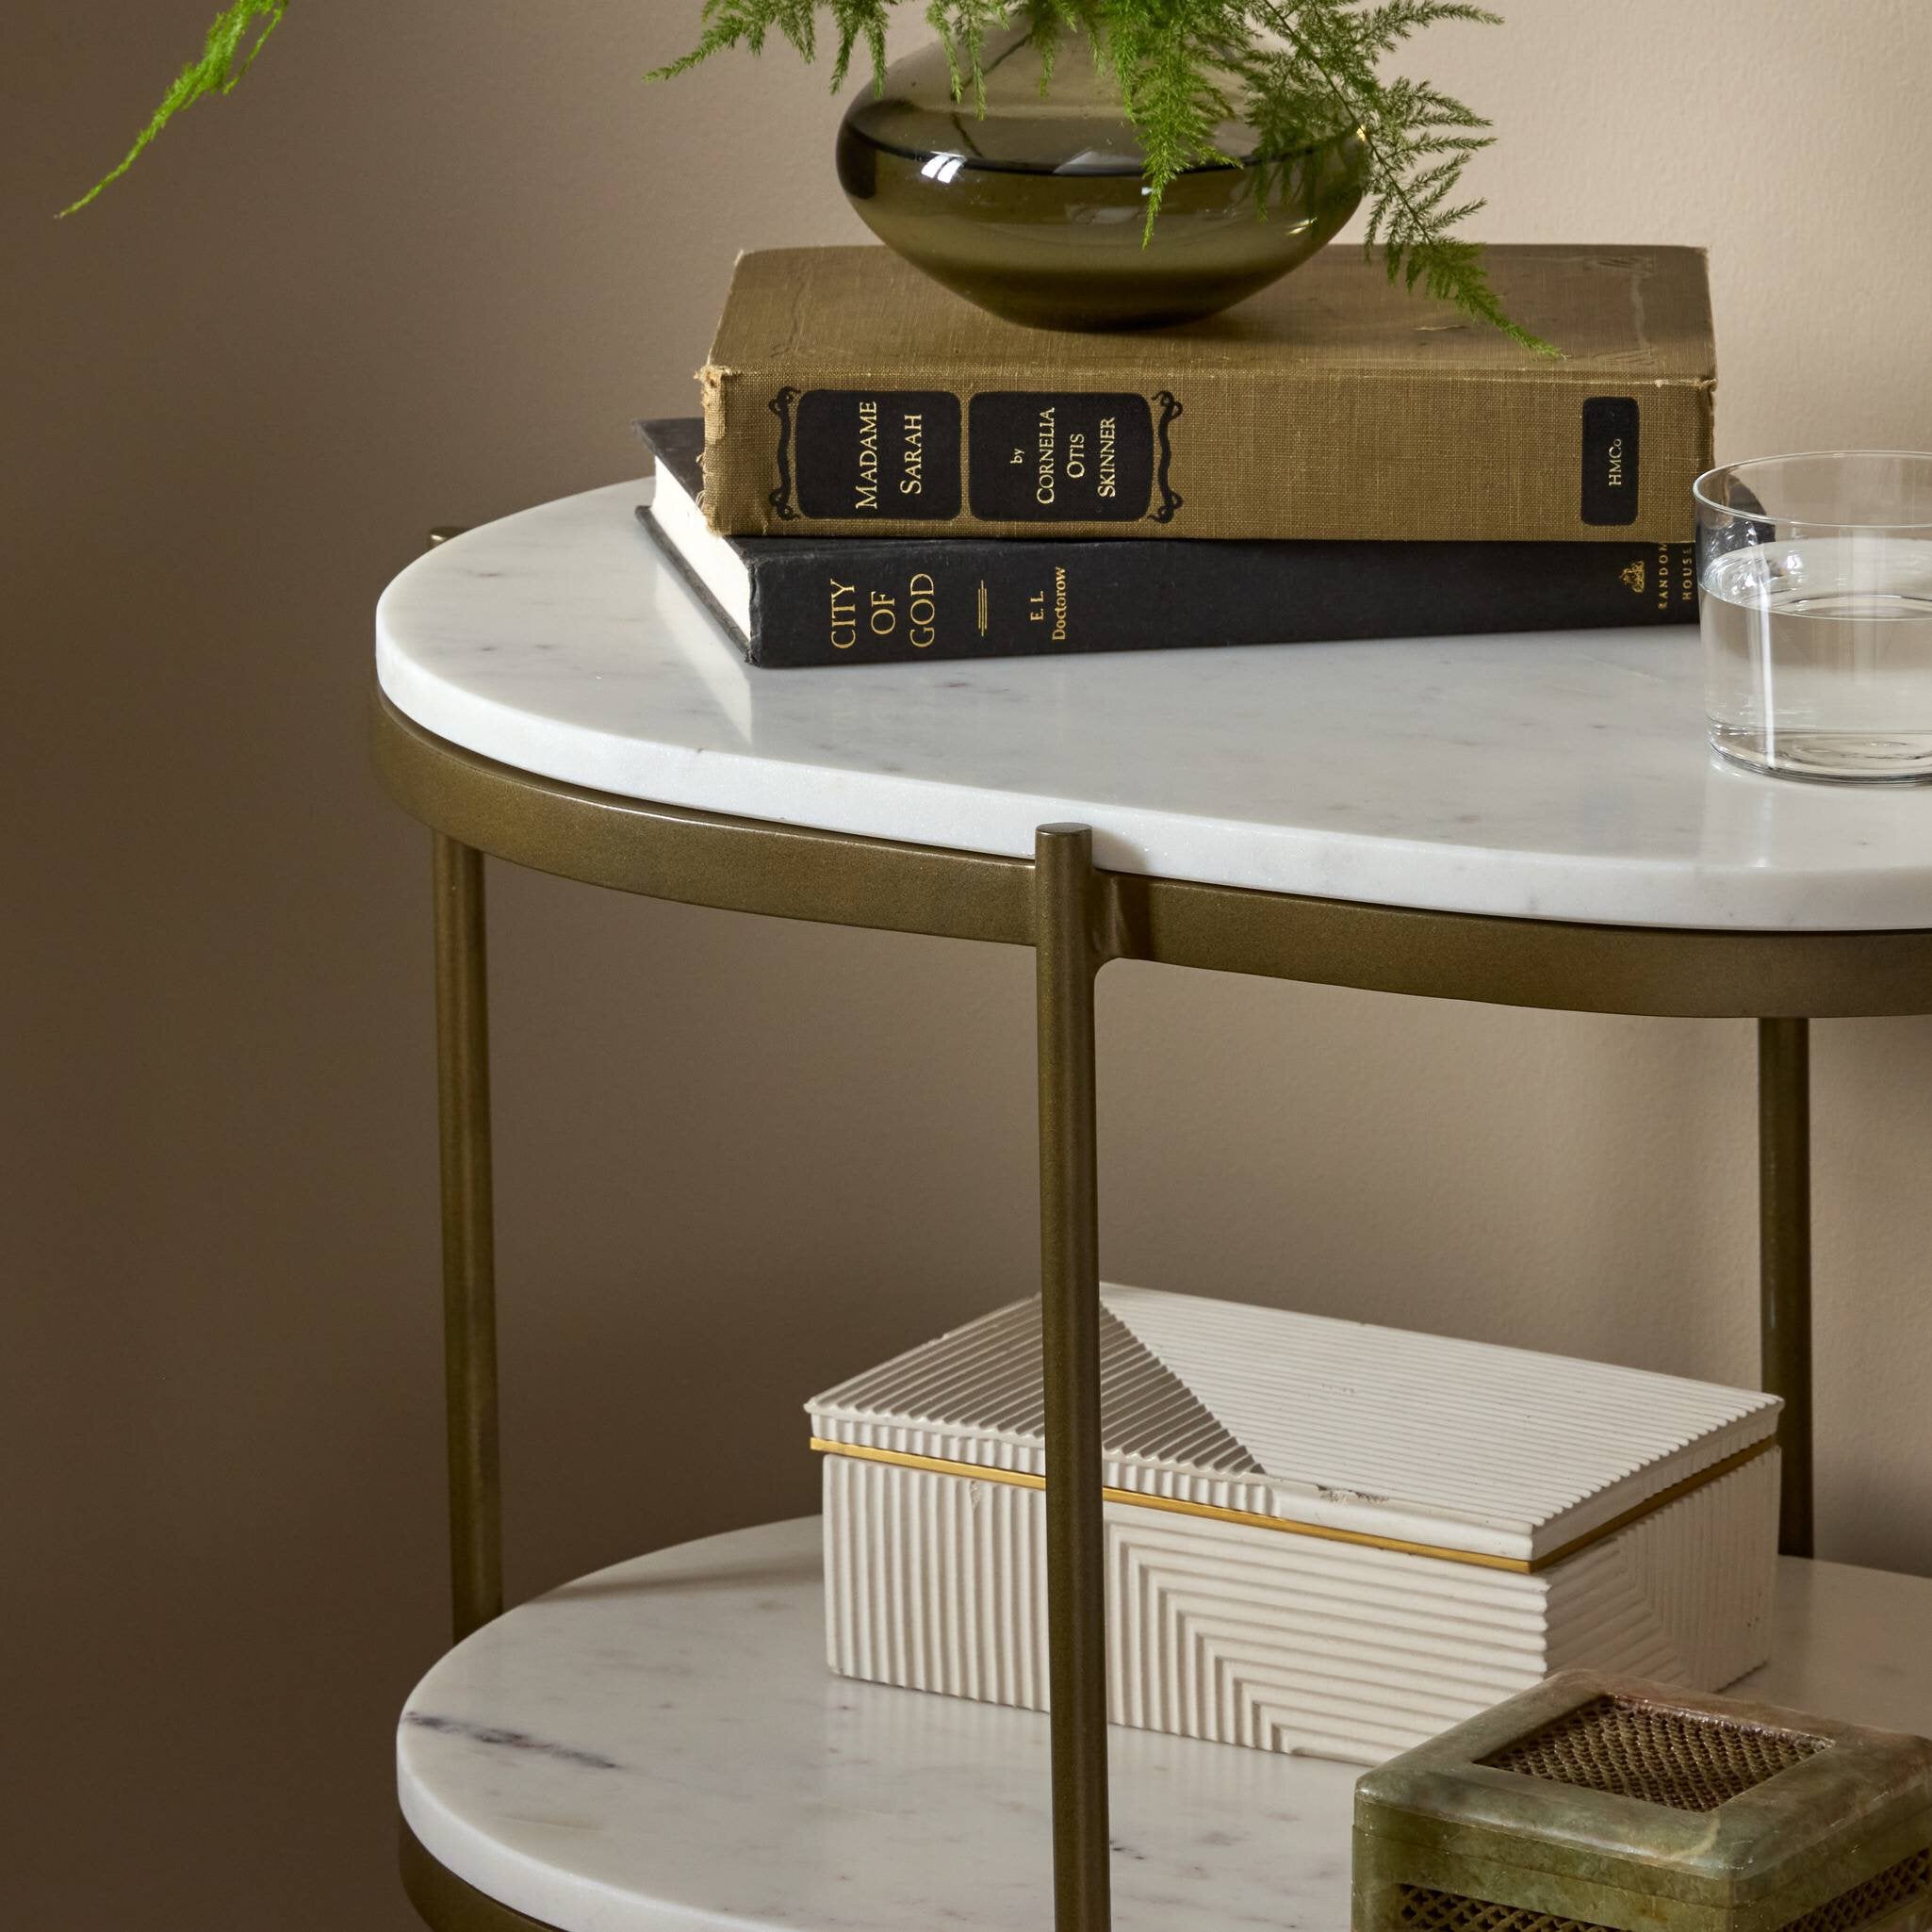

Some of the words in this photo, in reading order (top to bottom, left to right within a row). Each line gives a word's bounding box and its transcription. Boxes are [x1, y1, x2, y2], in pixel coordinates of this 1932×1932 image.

[856, 401, 877, 509] MADAME
[900, 415, 922, 494] SARAH
[1010, 449, 1024, 464] by
[1037, 407, 1055, 504] CORNELIA
[1067, 434, 1085, 478] OTIS
[1098, 418, 1116, 498] SKINNER
[830, 578, 856, 648] CITY
[871, 591, 895, 634] OF
[909, 574, 935, 647] GOD
[1030, 590, 1043, 603] L.
[1030, 607, 1043, 621] E.
[1052, 566, 1067, 640] Doctorow
